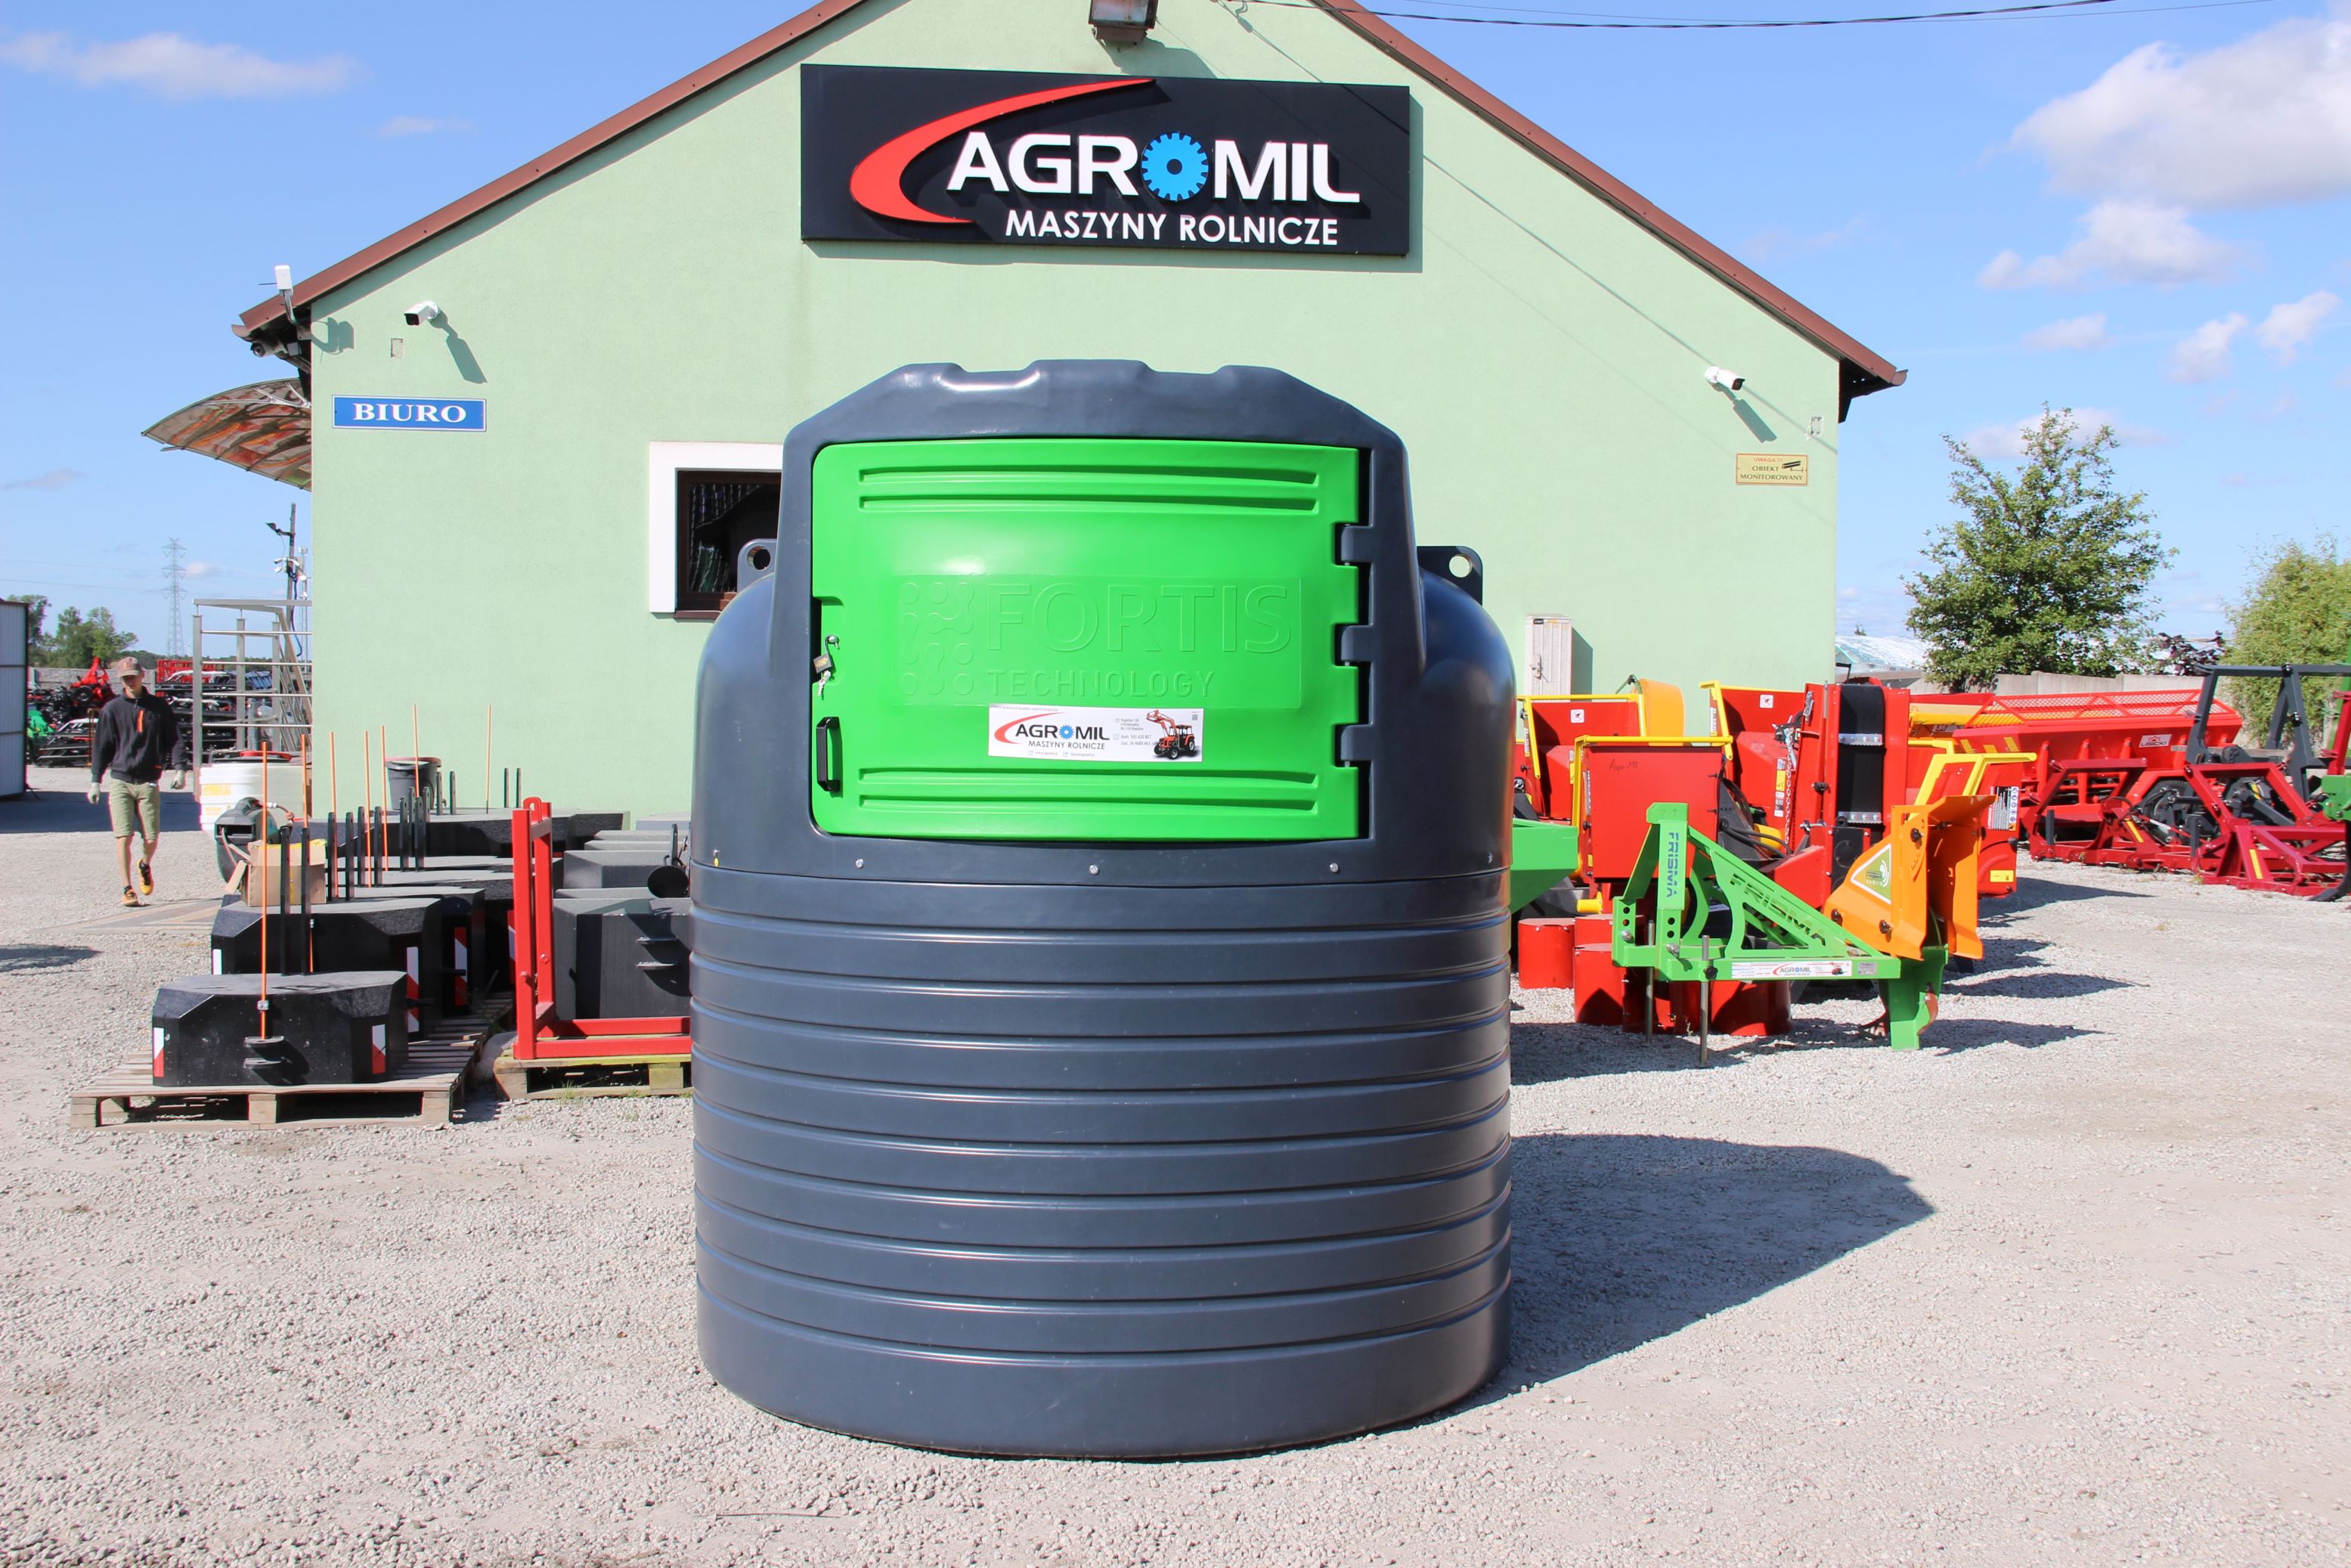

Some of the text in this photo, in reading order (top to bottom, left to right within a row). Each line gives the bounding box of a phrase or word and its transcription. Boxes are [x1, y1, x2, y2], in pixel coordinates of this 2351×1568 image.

[946, 131, 1360, 203] AGROMIL
[1005, 209, 1338, 245] MASZYNY ROLNICZE
[353, 403, 466, 423] BIURO
[987, 582, 1292, 654] FORTIS
[987, 669, 1215, 698] TECHNOLOGY
[1015, 724, 1110, 741] AGROMIL
[1028, 740, 1105, 750] MASZYNY ROLNICZE
[1666, 832, 1680, 898] FRISMA
[1730, 872, 1826, 947] FRISMA
